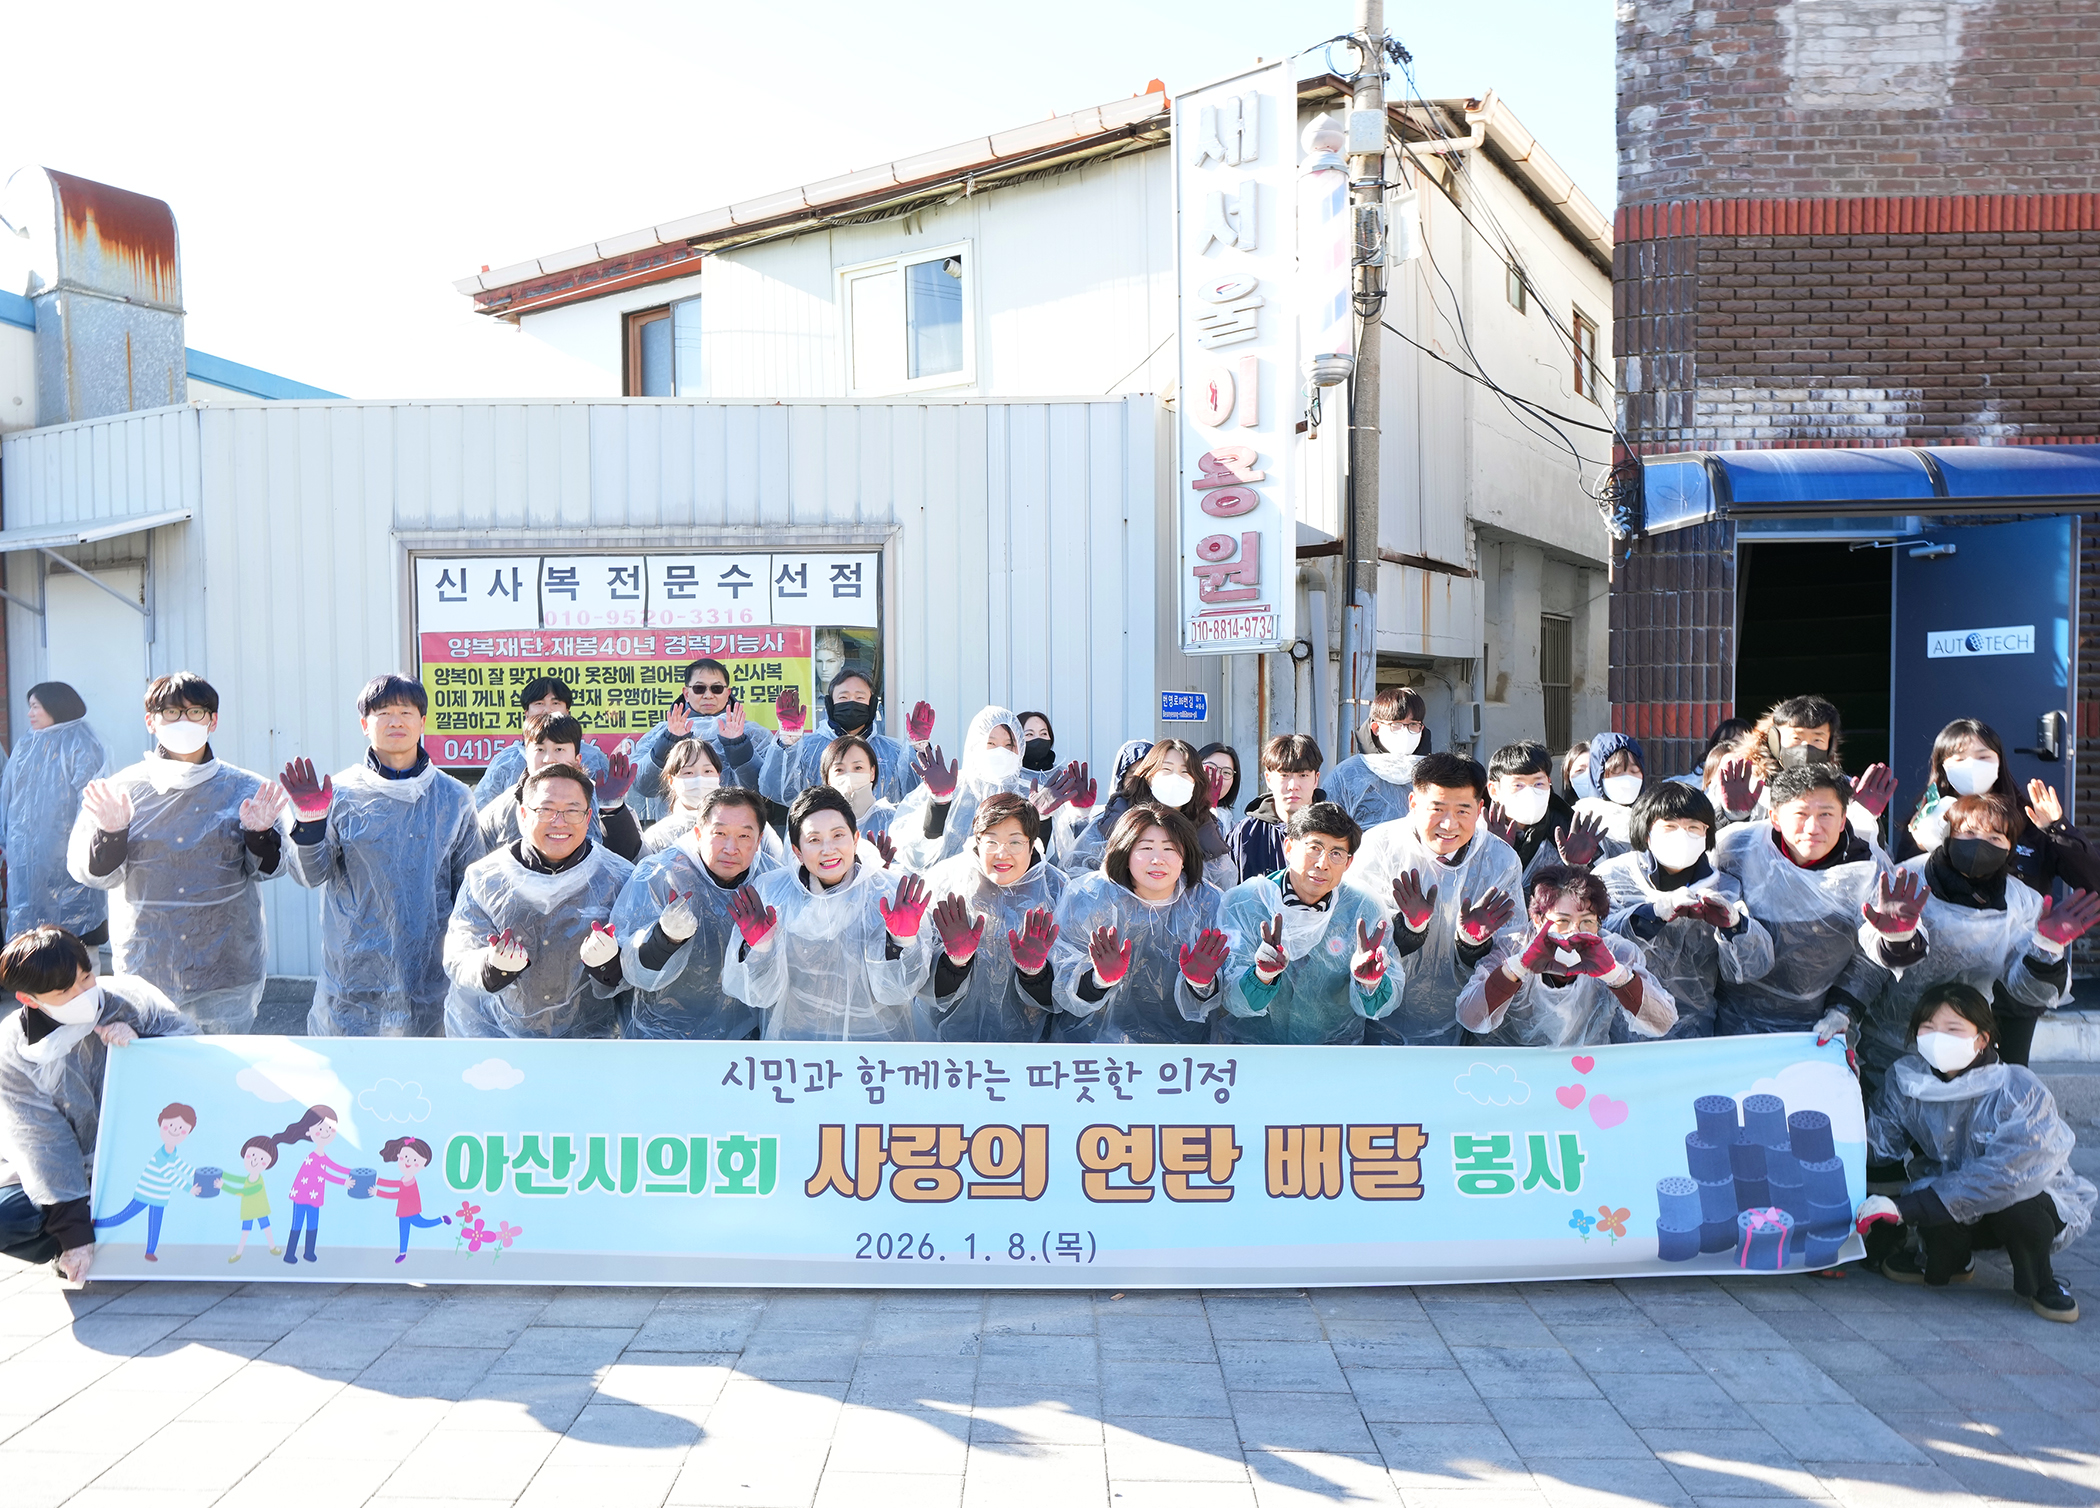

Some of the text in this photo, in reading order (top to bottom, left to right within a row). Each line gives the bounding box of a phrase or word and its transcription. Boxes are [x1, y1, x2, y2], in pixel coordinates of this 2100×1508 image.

[544, 608, 754, 627] 010-9520-3316
[447, 632, 786, 659] 양복재단.재봉40년 경력기능사
[434, 667, 484, 686] 양복이
[488, 667, 505, 686] 잘
[509, 667, 542, 686] 맞지
[585, 665, 635, 685] 옷장에
[732, 662, 783, 682] 신사복
[434, 690, 467, 708] 이제
[472, 689, 506, 708] 꺼내
[571, 688, 602, 707] 현재
[607, 687, 674, 706] 유행하는
[435, 711, 501, 730] 깔끔하고
[721, 1055, 1239, 1105] 시민과 함께하는 따뜻한 의정
[443, 1123, 1588, 1204] 아산시의회 사랑의 연탄 배달 봉사
[855, 1230, 1098, 1264] 2026. 1. 8.(목)
